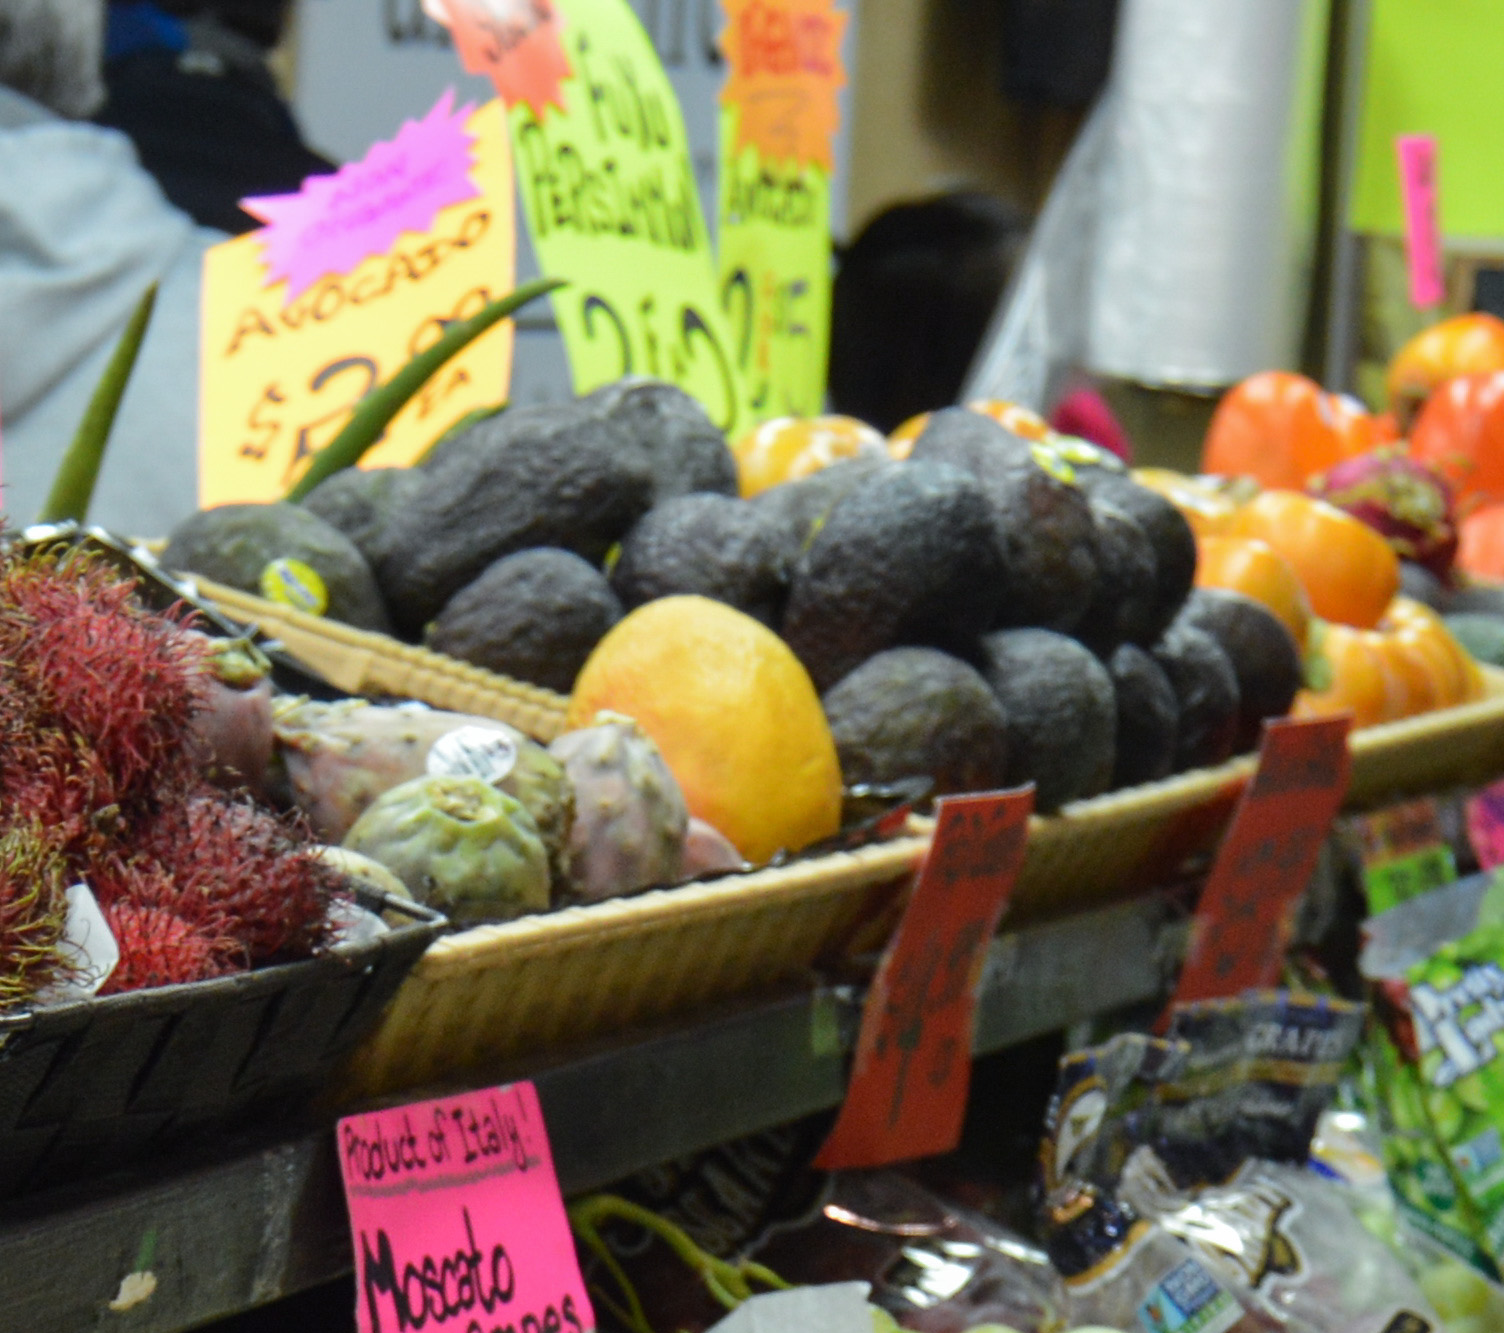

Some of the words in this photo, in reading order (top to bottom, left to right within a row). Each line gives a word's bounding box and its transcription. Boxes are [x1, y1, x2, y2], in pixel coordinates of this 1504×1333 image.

[225, 210, 491, 357] AVOCADO
[344, 1119, 429, 1182] Product
[427, 1107, 448, 1164] of
